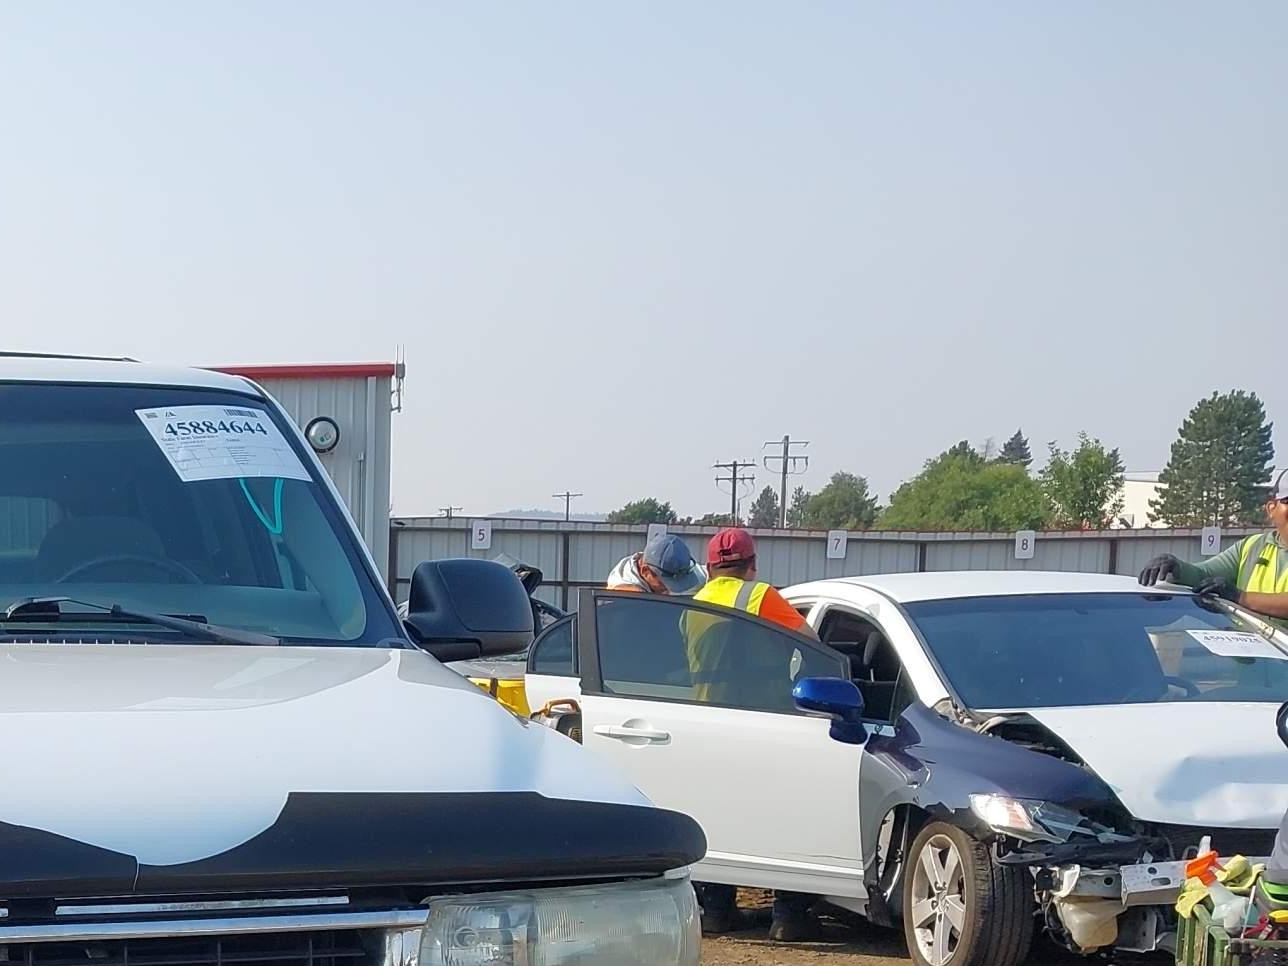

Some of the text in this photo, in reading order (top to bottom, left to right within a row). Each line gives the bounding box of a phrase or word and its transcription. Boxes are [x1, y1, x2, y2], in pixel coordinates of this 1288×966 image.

[165, 420, 268, 435] 45884644
[478, 528, 485, 542] 5
[1207, 534, 1215, 547] 9
[833, 538, 841, 551] 7
[1021, 538, 1029, 551] 8
